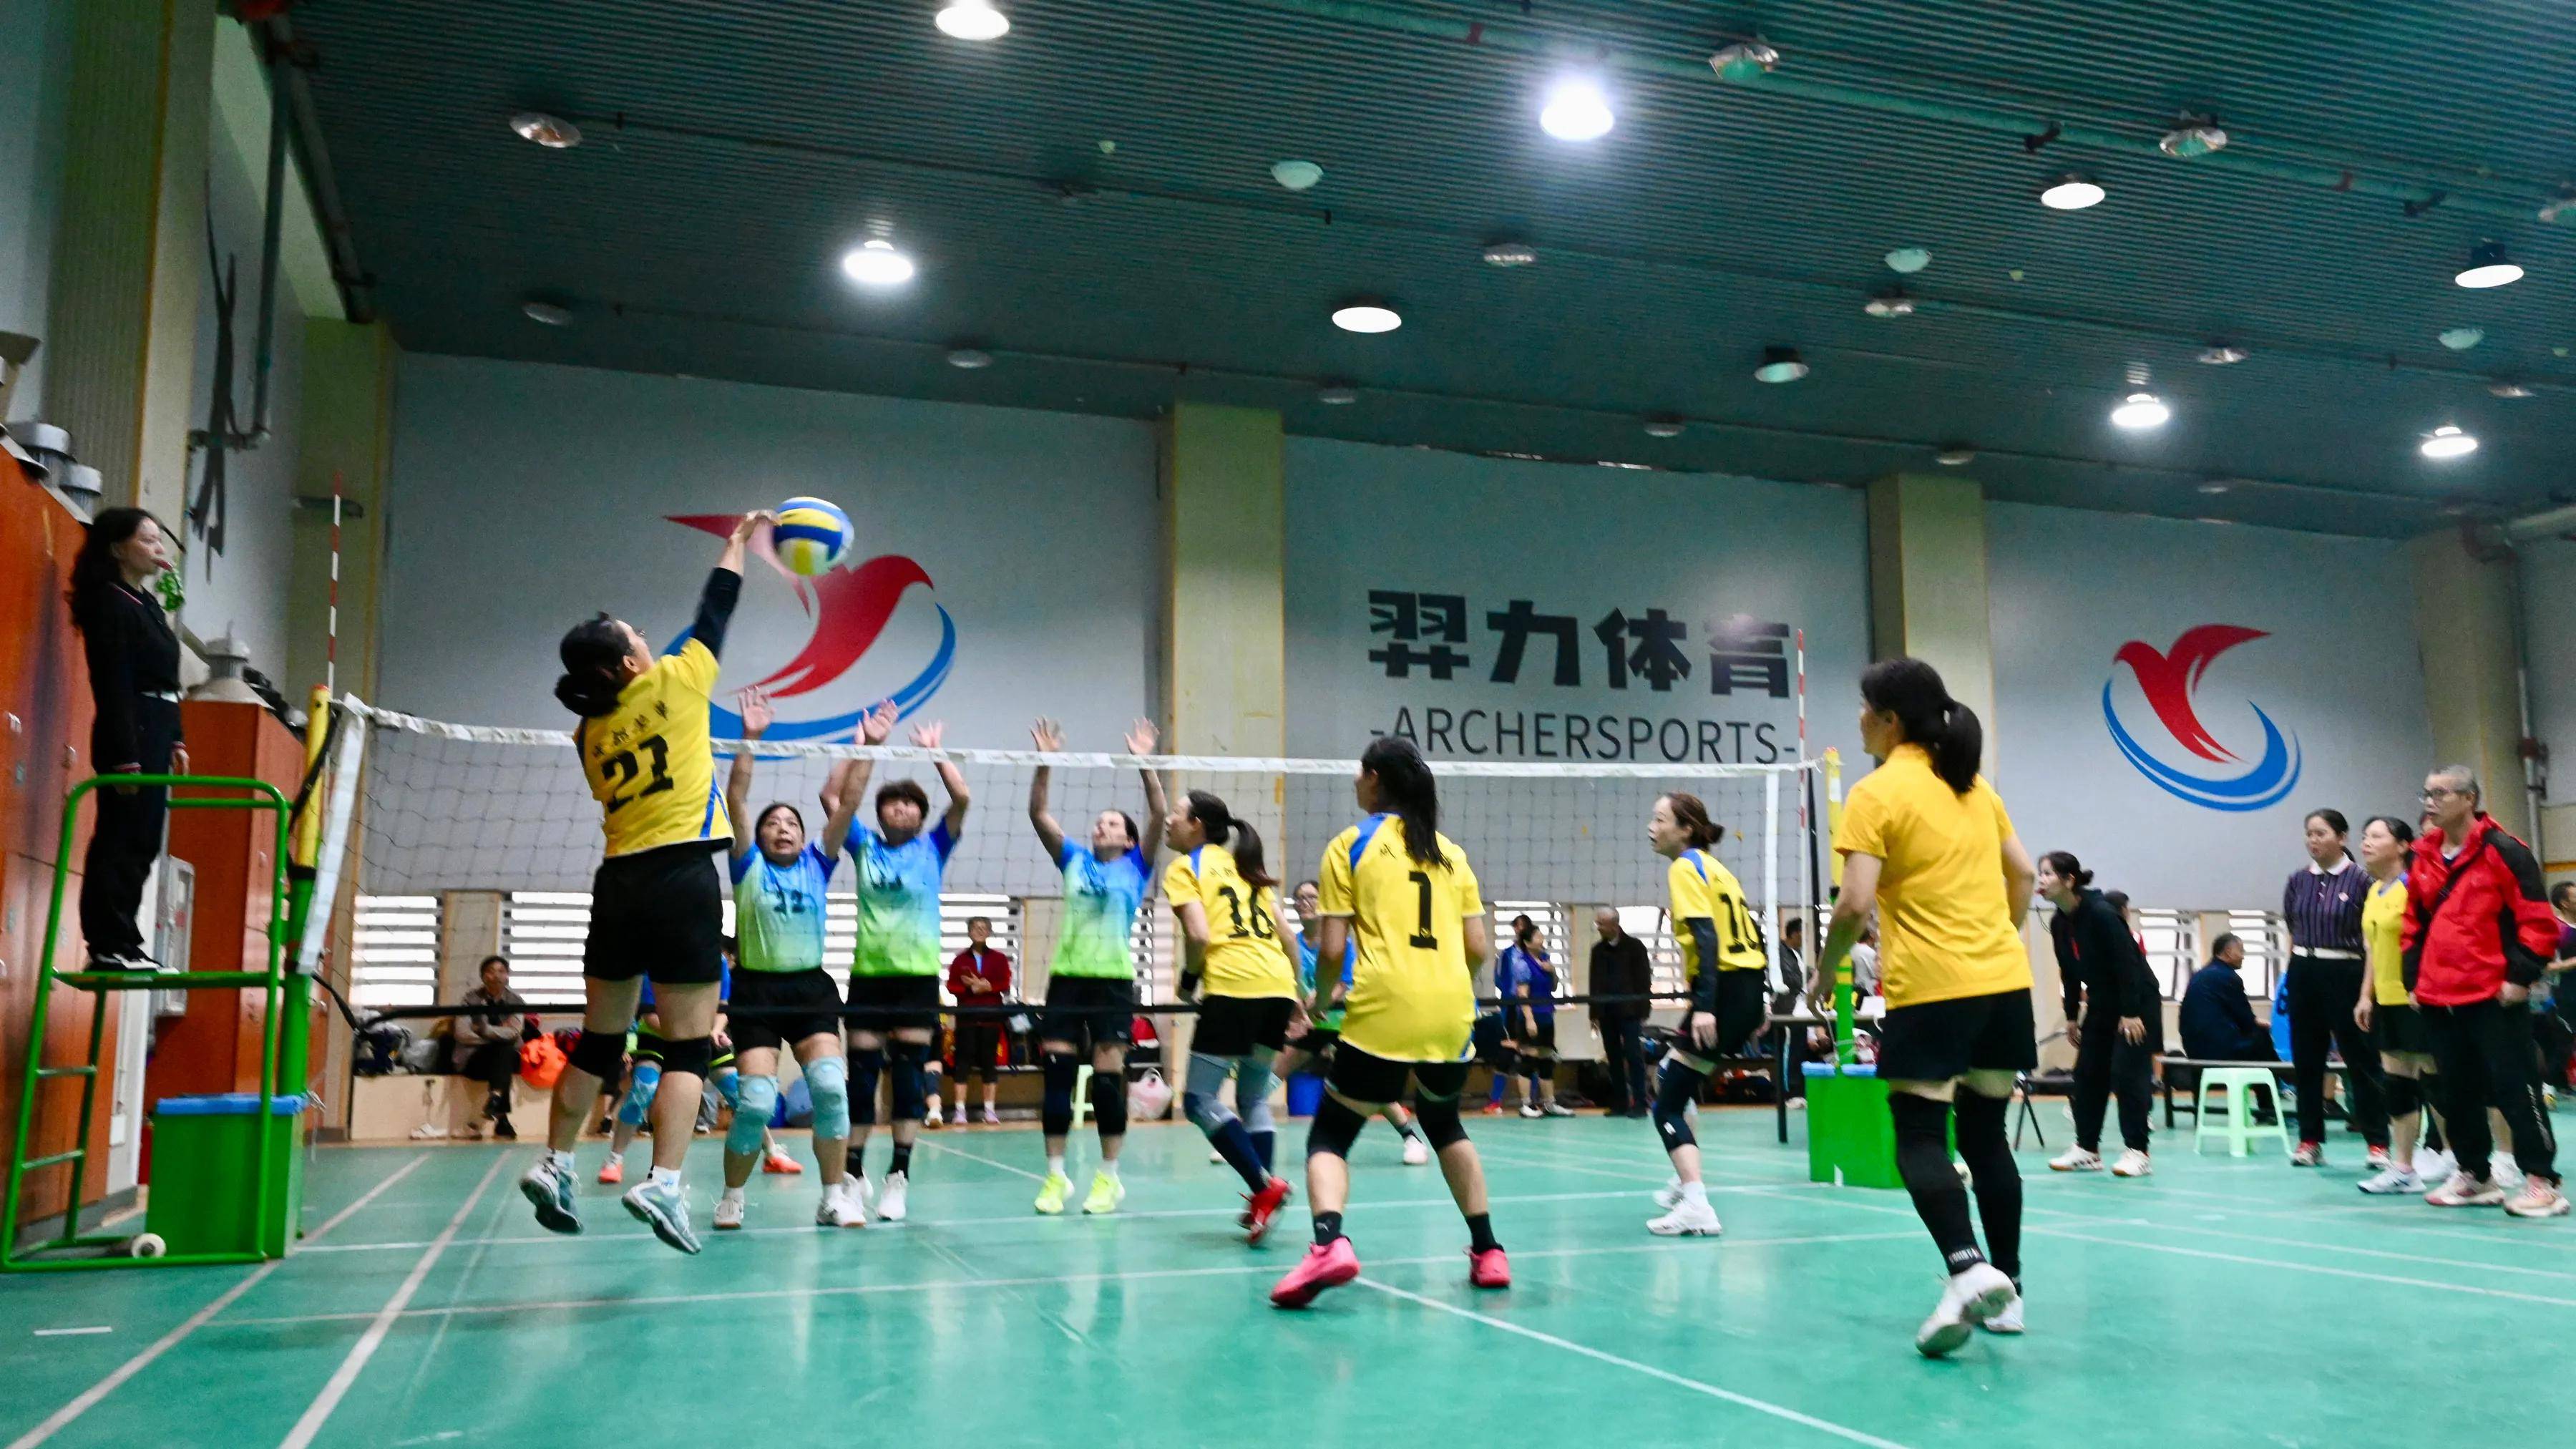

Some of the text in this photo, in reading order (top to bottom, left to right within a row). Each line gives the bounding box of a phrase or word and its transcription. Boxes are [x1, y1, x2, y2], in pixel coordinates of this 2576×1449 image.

[1368, 589, 1790, 698] 羿力体育
[602, 733, 674, 814] 21
[1219, 885, 1276, 940] 16
[1408, 870, 1438, 950] 1
[1719, 893, 1766, 955] 10
